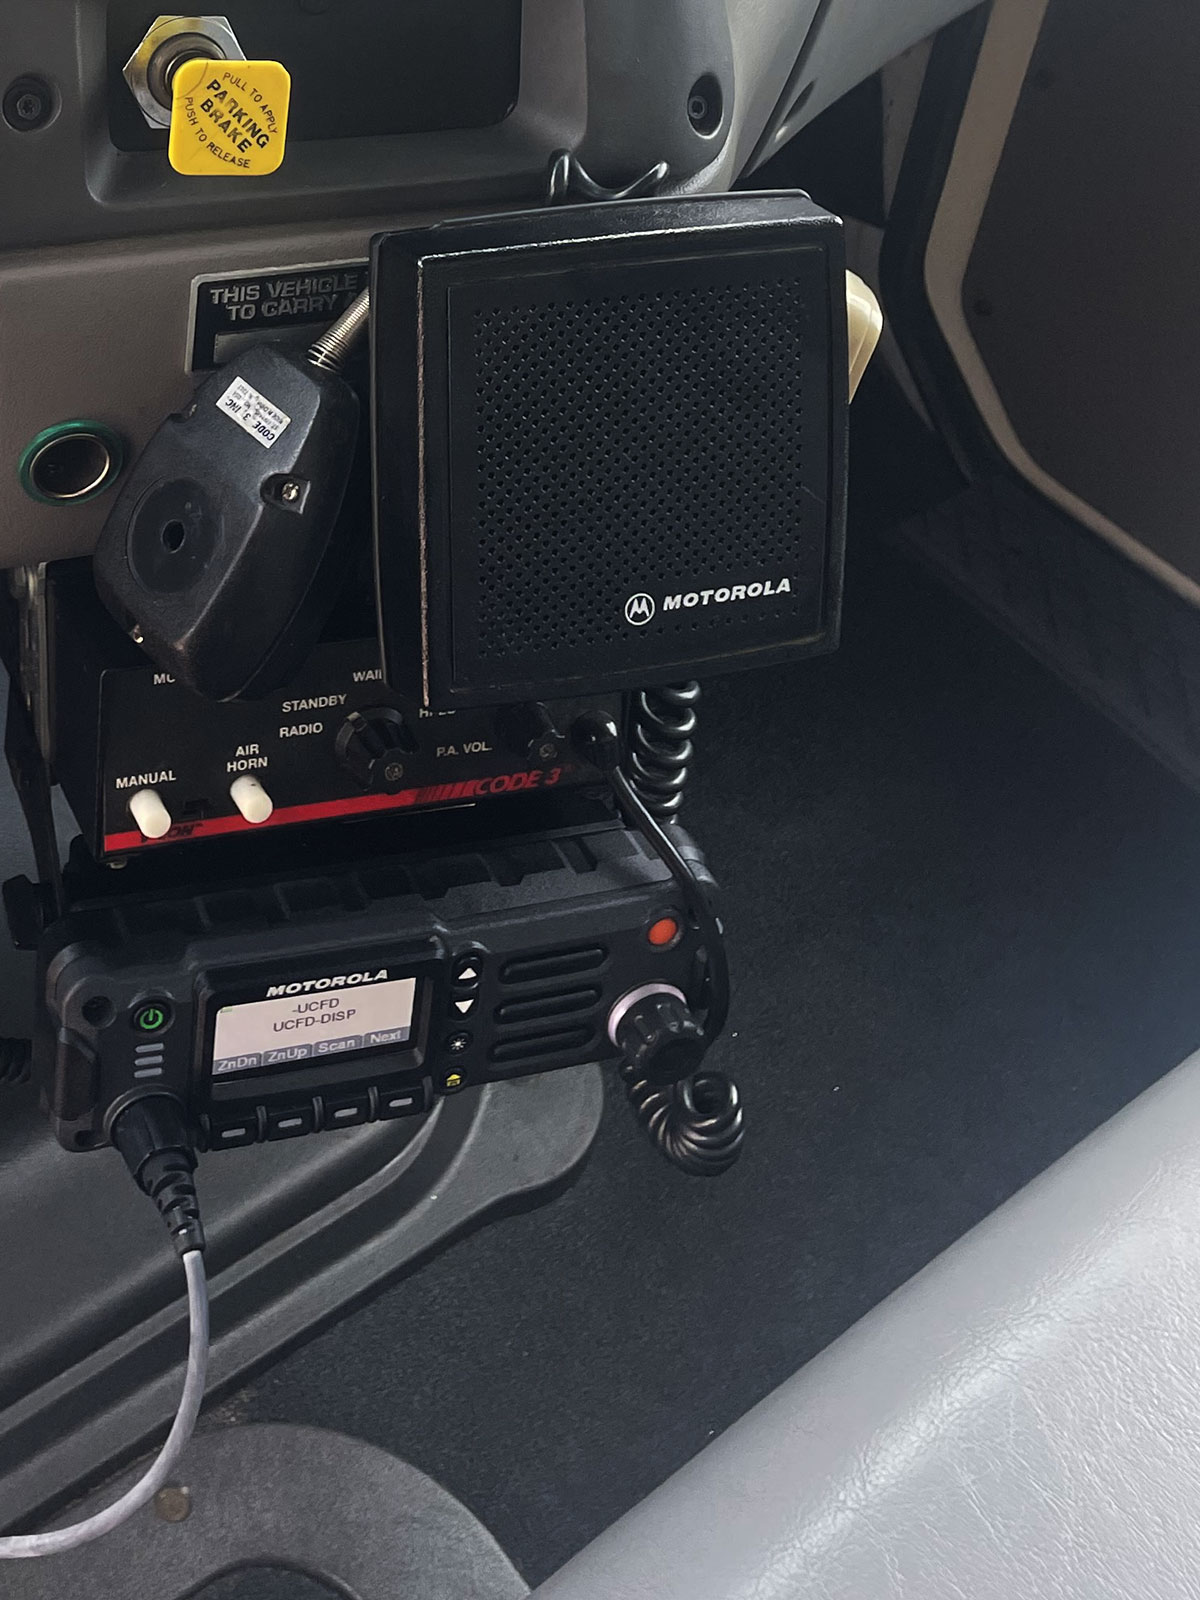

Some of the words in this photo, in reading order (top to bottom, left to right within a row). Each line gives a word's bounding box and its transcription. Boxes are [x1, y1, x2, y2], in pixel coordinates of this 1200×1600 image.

[206, 79, 270, 150] PARKING
[222, 72, 248, 92] PULL
[250, 88, 264, 103] TO
[260, 104, 278, 134] APPLY
[184, 96, 198, 126] PUSH
[195, 128, 208, 142] TO
[206, 142, 251, 168] RELEASE
[200, 98, 253, 153] BRAKE
[210, 284, 260, 305] THIS
[266, 273, 358, 298] VEHICLE
[226, 304, 256, 321] TO
[261, 294, 338, 317] CARRY
[252, 420, 275, 440] CODE
[663, 578, 790, 610] MOTOROLA
[282, 694, 347, 712] STANDBY
[280, 722, 324, 738] RADIO
[236, 744, 260, 756] AIR
[436, 746, 459, 758] P.A.
[226, 757, 268, 772] HORN
[116, 770, 176, 789] MANUAL
[476, 770, 543, 795] CODE
[546, 768, 562, 784] 3
[266, 969, 388, 998] MOTOROLA
[292, 998, 340, 1014] -UCFD
[273, 1008, 356, 1033] UCFD-DISP
[217, 1056, 257, 1072] ZnDn
[267, 1048, 308, 1064] ZnUp
[318, 1038, 356, 1053] Scan
[370, 1030, 402, 1044] Next
